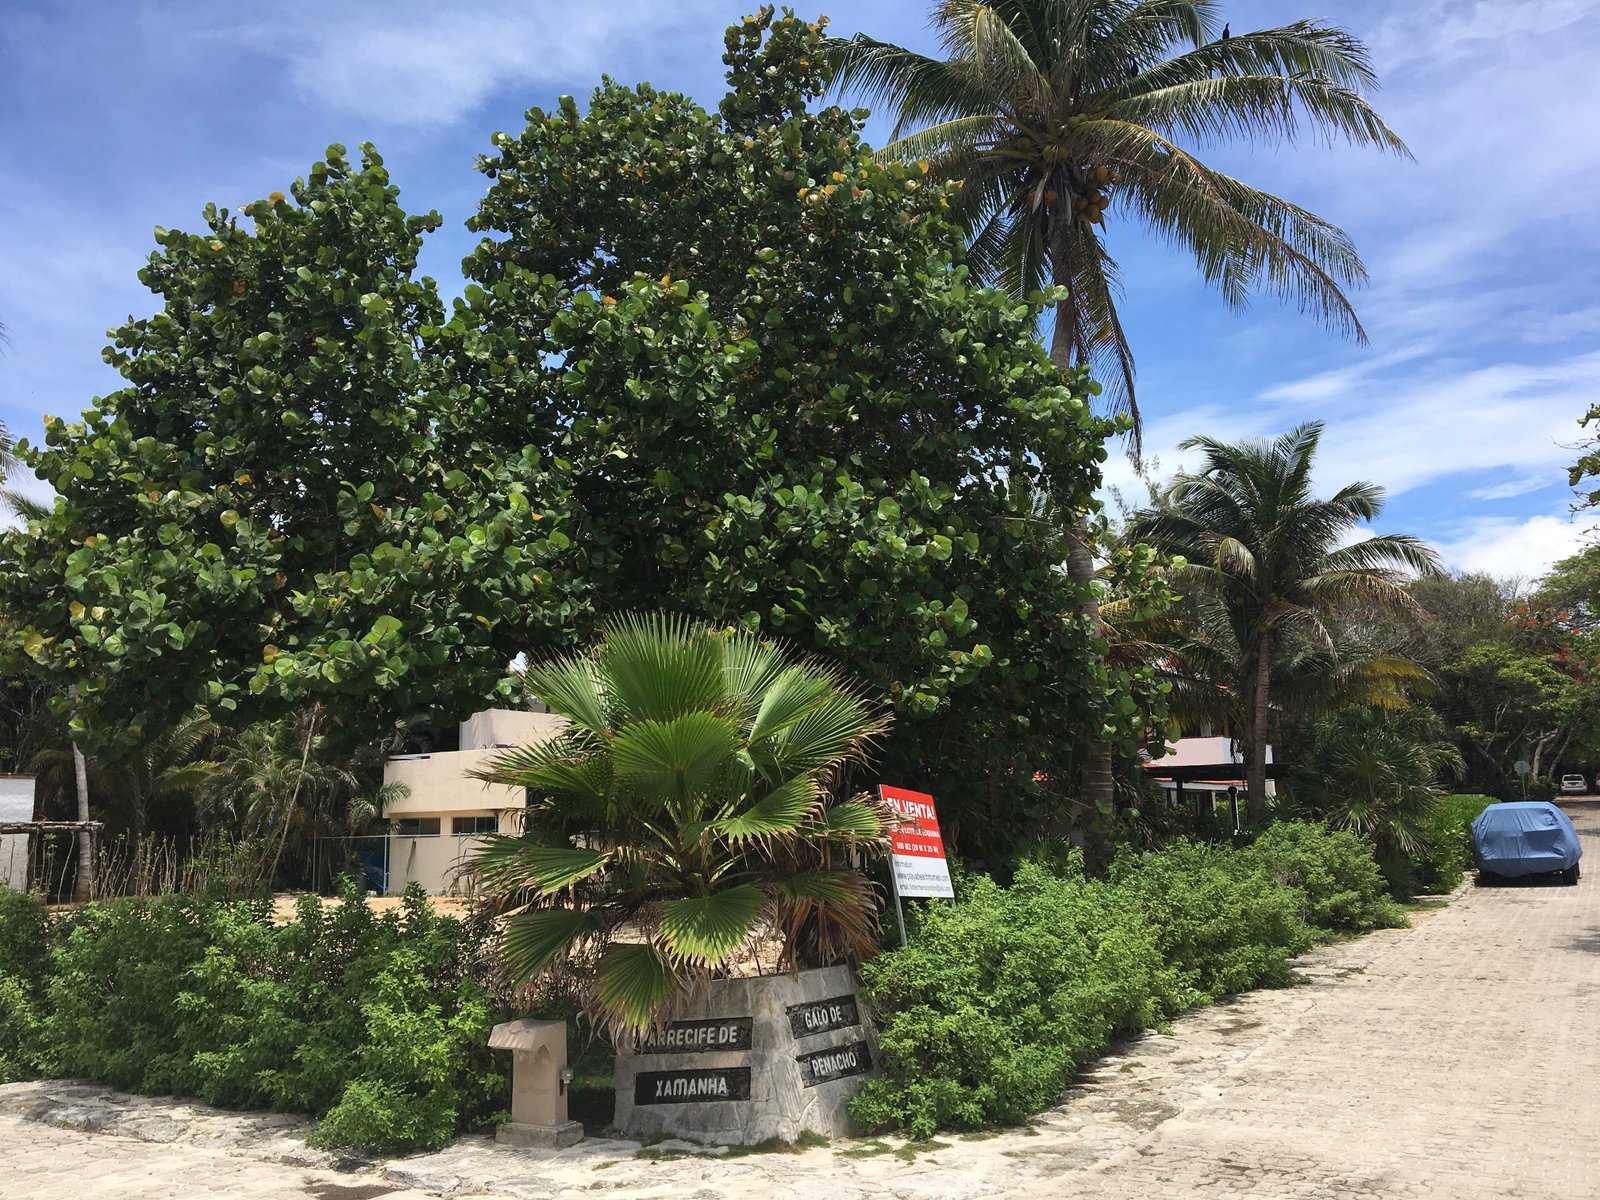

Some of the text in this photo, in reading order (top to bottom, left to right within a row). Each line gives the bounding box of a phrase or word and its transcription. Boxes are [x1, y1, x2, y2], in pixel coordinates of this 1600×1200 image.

[902, 800, 936, 820] VENTA!
[804, 1006, 842, 1028] GALO DE
[647, 1025, 738, 1047] ARRECIFE DE
[811, 1051, 857, 1076] PENACHO
[655, 1076, 728, 1097] XAMANHA
